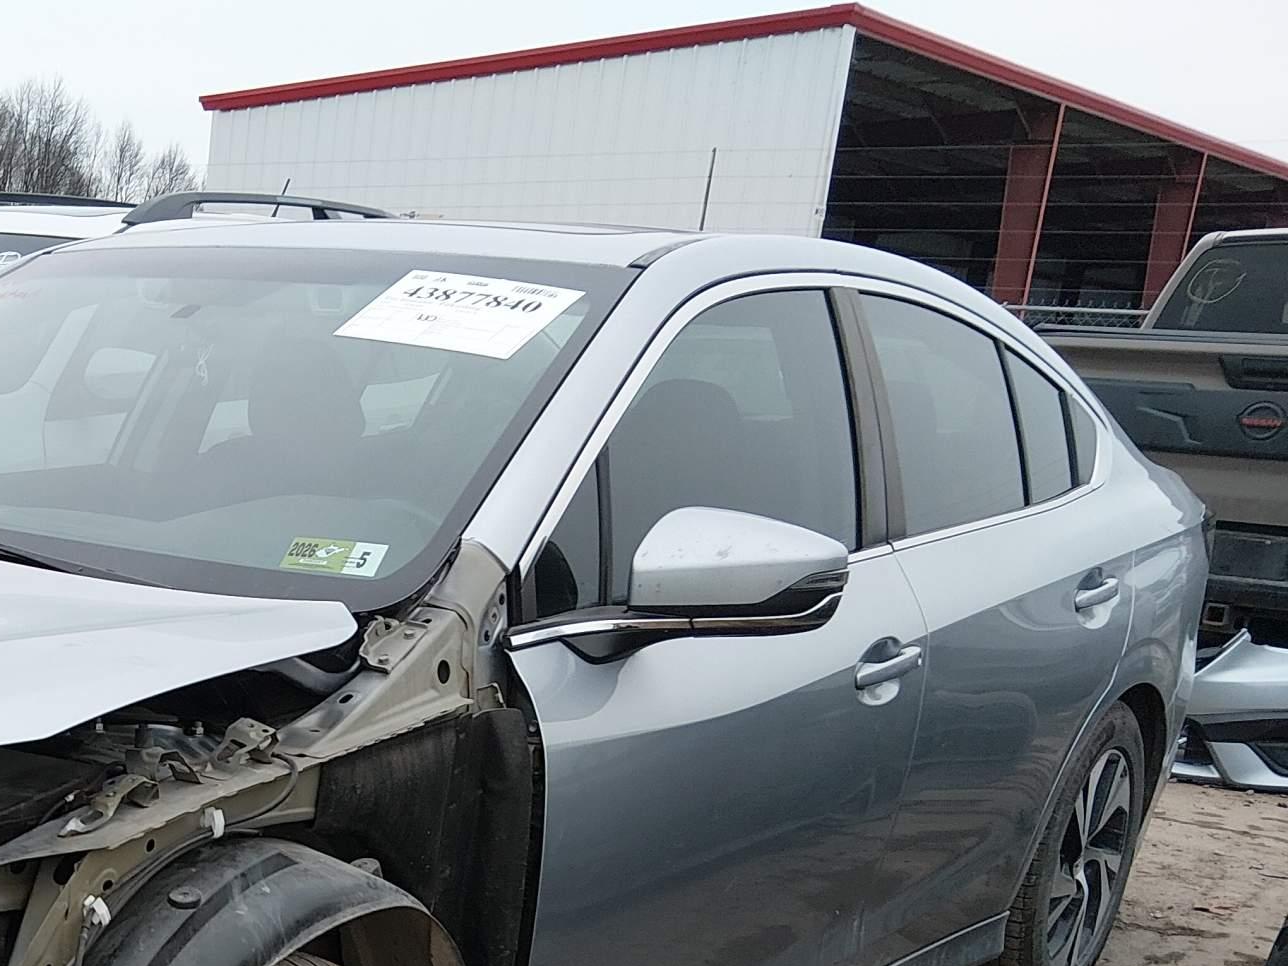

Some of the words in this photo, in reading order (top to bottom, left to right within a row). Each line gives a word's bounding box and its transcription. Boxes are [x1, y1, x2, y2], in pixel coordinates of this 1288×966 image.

[403, 285, 543, 314] 43877840
[1241, 417, 1282, 428] NISSAN
[287, 541, 320, 558] 2026
[355, 551, 372, 569] 5
